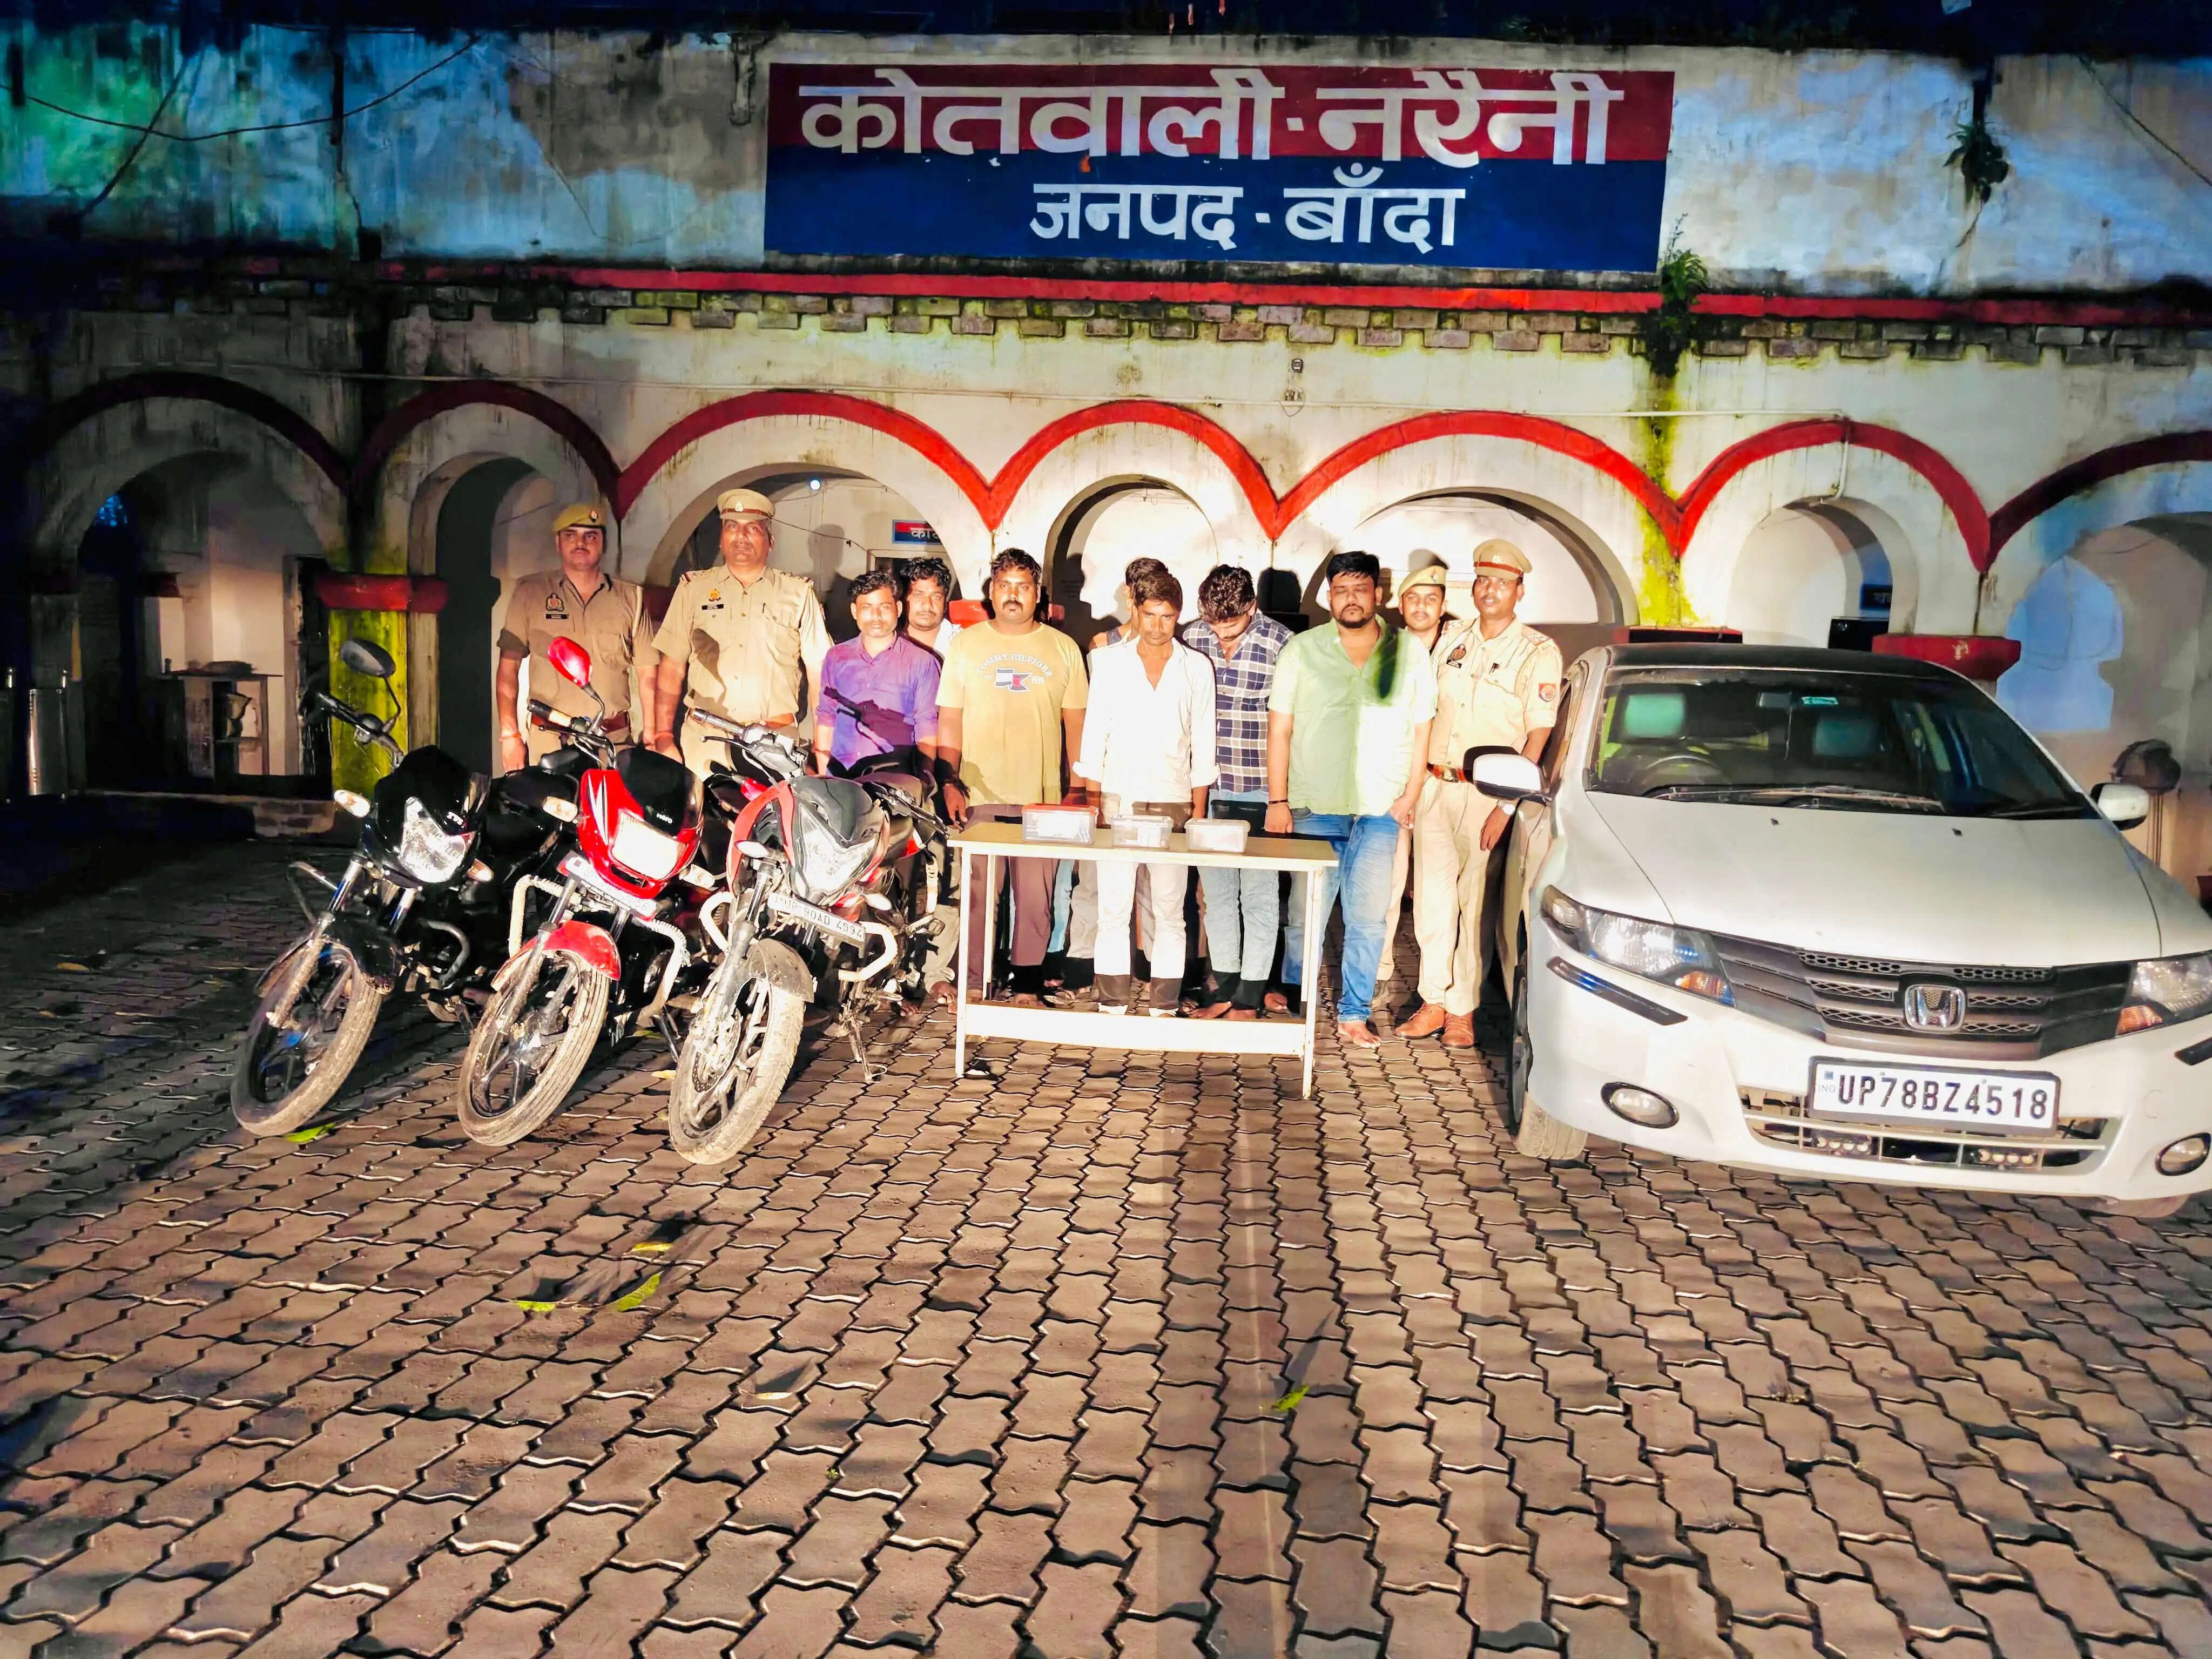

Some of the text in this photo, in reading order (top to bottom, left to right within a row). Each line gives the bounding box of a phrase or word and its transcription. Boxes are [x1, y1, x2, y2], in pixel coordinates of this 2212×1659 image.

[799, 68, 1285, 160] कोतवाली
[1317, 70, 1624, 168] नरैनी
[1030, 184, 1243, 250] जनपद
[1284, 162, 1466, 254] बाँदा
[1838, 1074, 2048, 1120] UP78BZ4518
